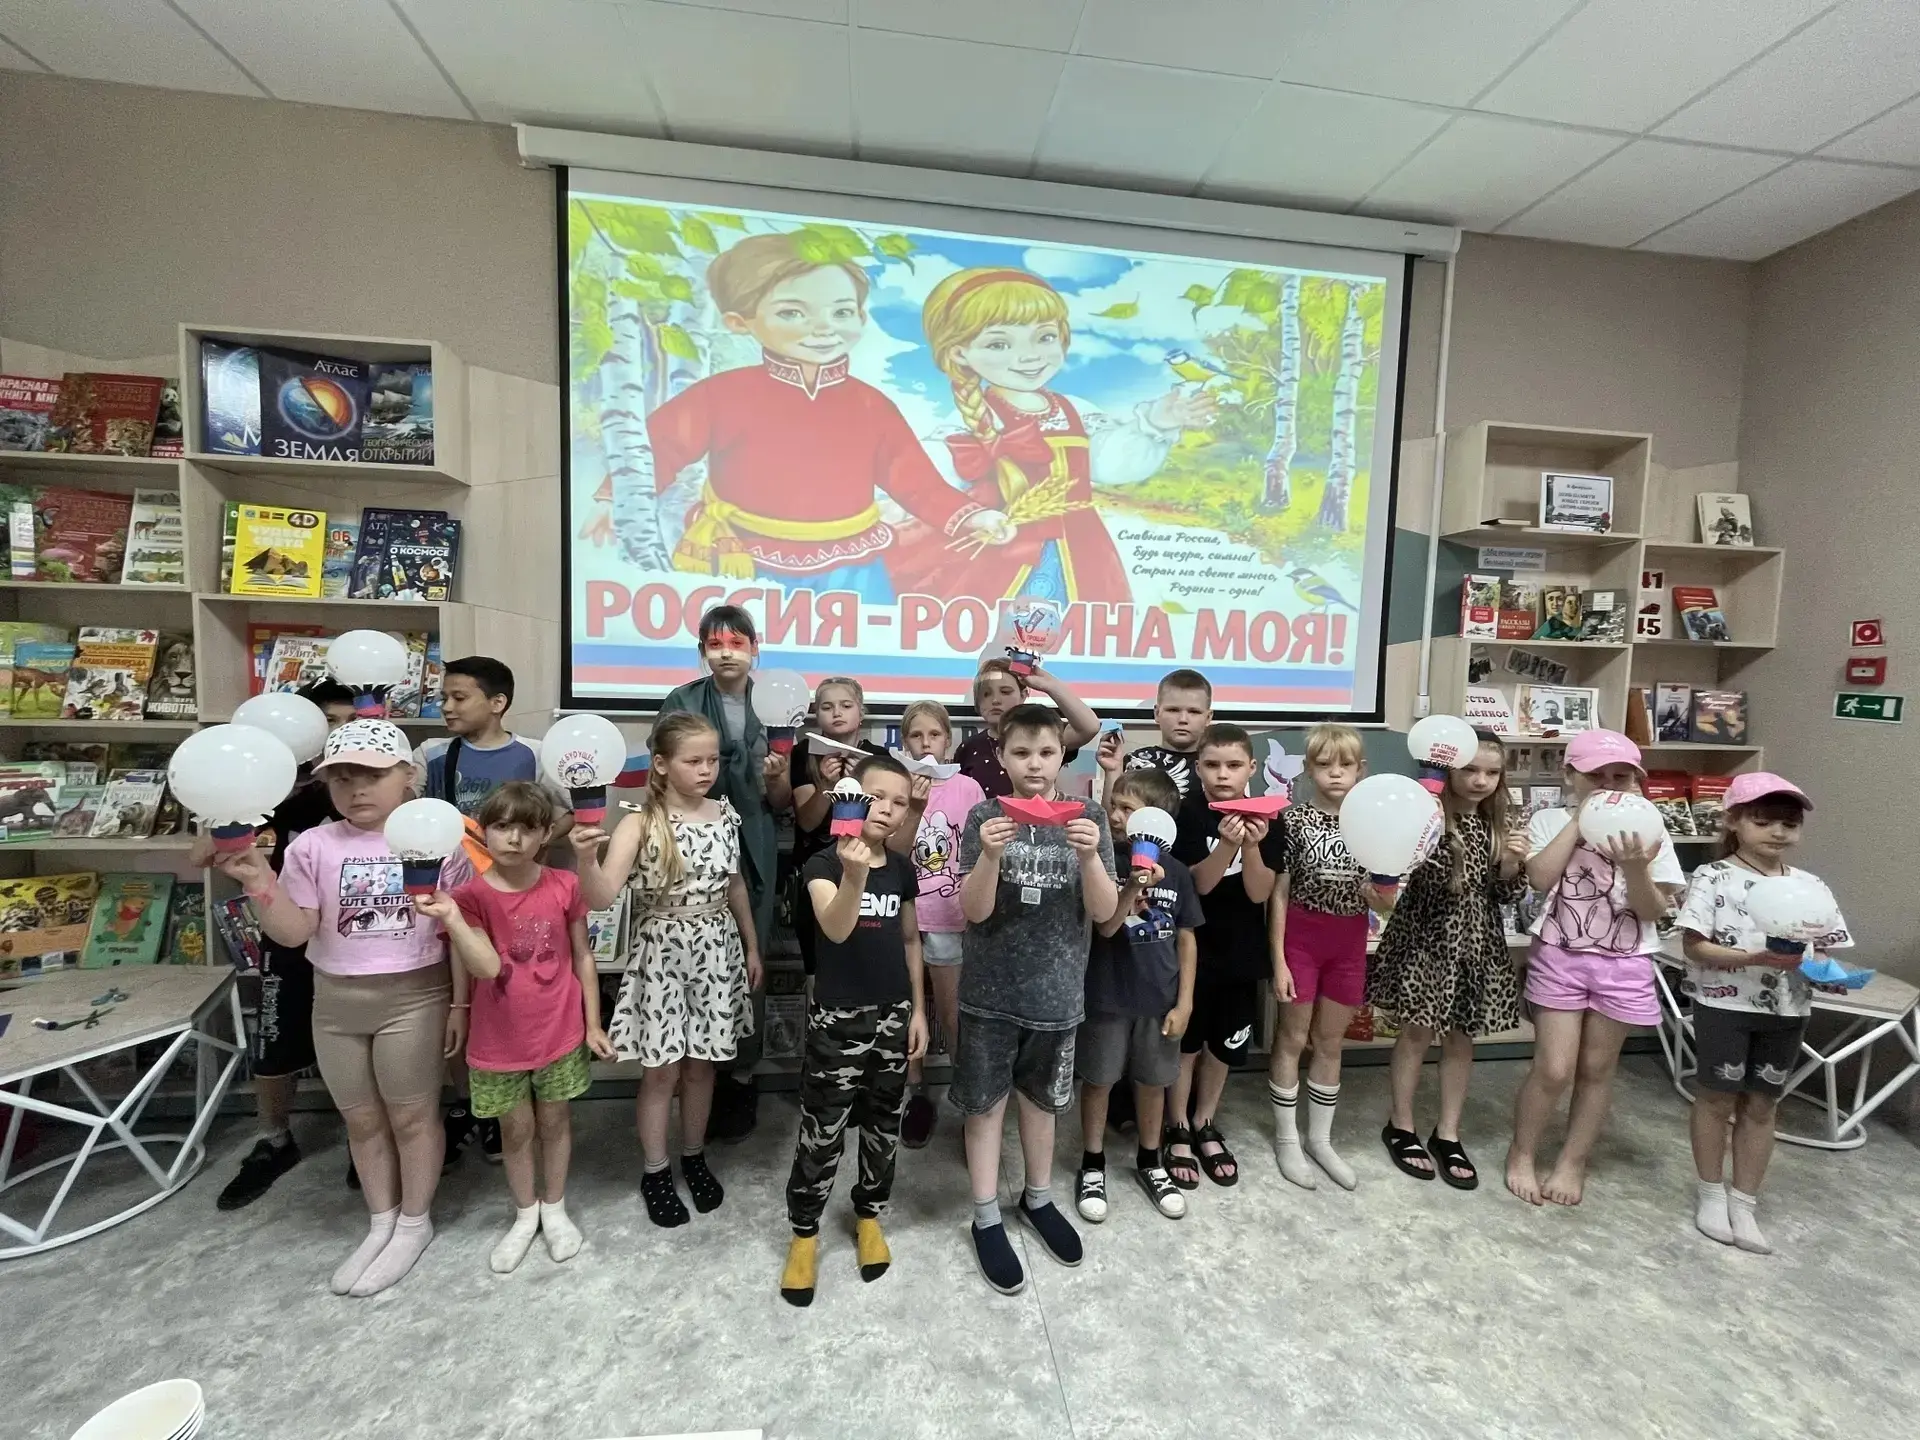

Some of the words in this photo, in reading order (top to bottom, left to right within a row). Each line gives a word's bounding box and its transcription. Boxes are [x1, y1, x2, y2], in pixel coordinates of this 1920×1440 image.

[314, 360, 359, 378] Атлас
[274, 439, 359, 463] ЗЕМЛЯ
[362, 447, 432, 461] ОТКРЫТИЙ
[290, 513, 316, 526] 4D
[368, 522, 388, 530] АТЛ
[1117, 529, 1171, 542] Славная
[1176, 532, 1221, 546] Россия,
[400, 548, 450, 557] КОСМОСЕ
[1162, 550, 1204, 562] щедра,
[1208, 551, 1256, 563] сильна!
[1132, 564, 1176, 578] Стран
[1179, 569, 1195, 577] на
[1199, 568, 1235, 579] свете
[1238, 571, 1278, 582] много,
[1170, 582, 1214, 597] Родина
[1229, 585, 1265, 597] одна!
[1191, 608, 1348, 665] МОЯ!
[277, 649, 317, 658] ЭРУДИТА
[147, 702, 198, 714] ЖИВОТНЫ
[340, 897, 367, 906] CUTE
[373, 896, 412, 906] EDITIO
[859, 891, 901, 917] END
